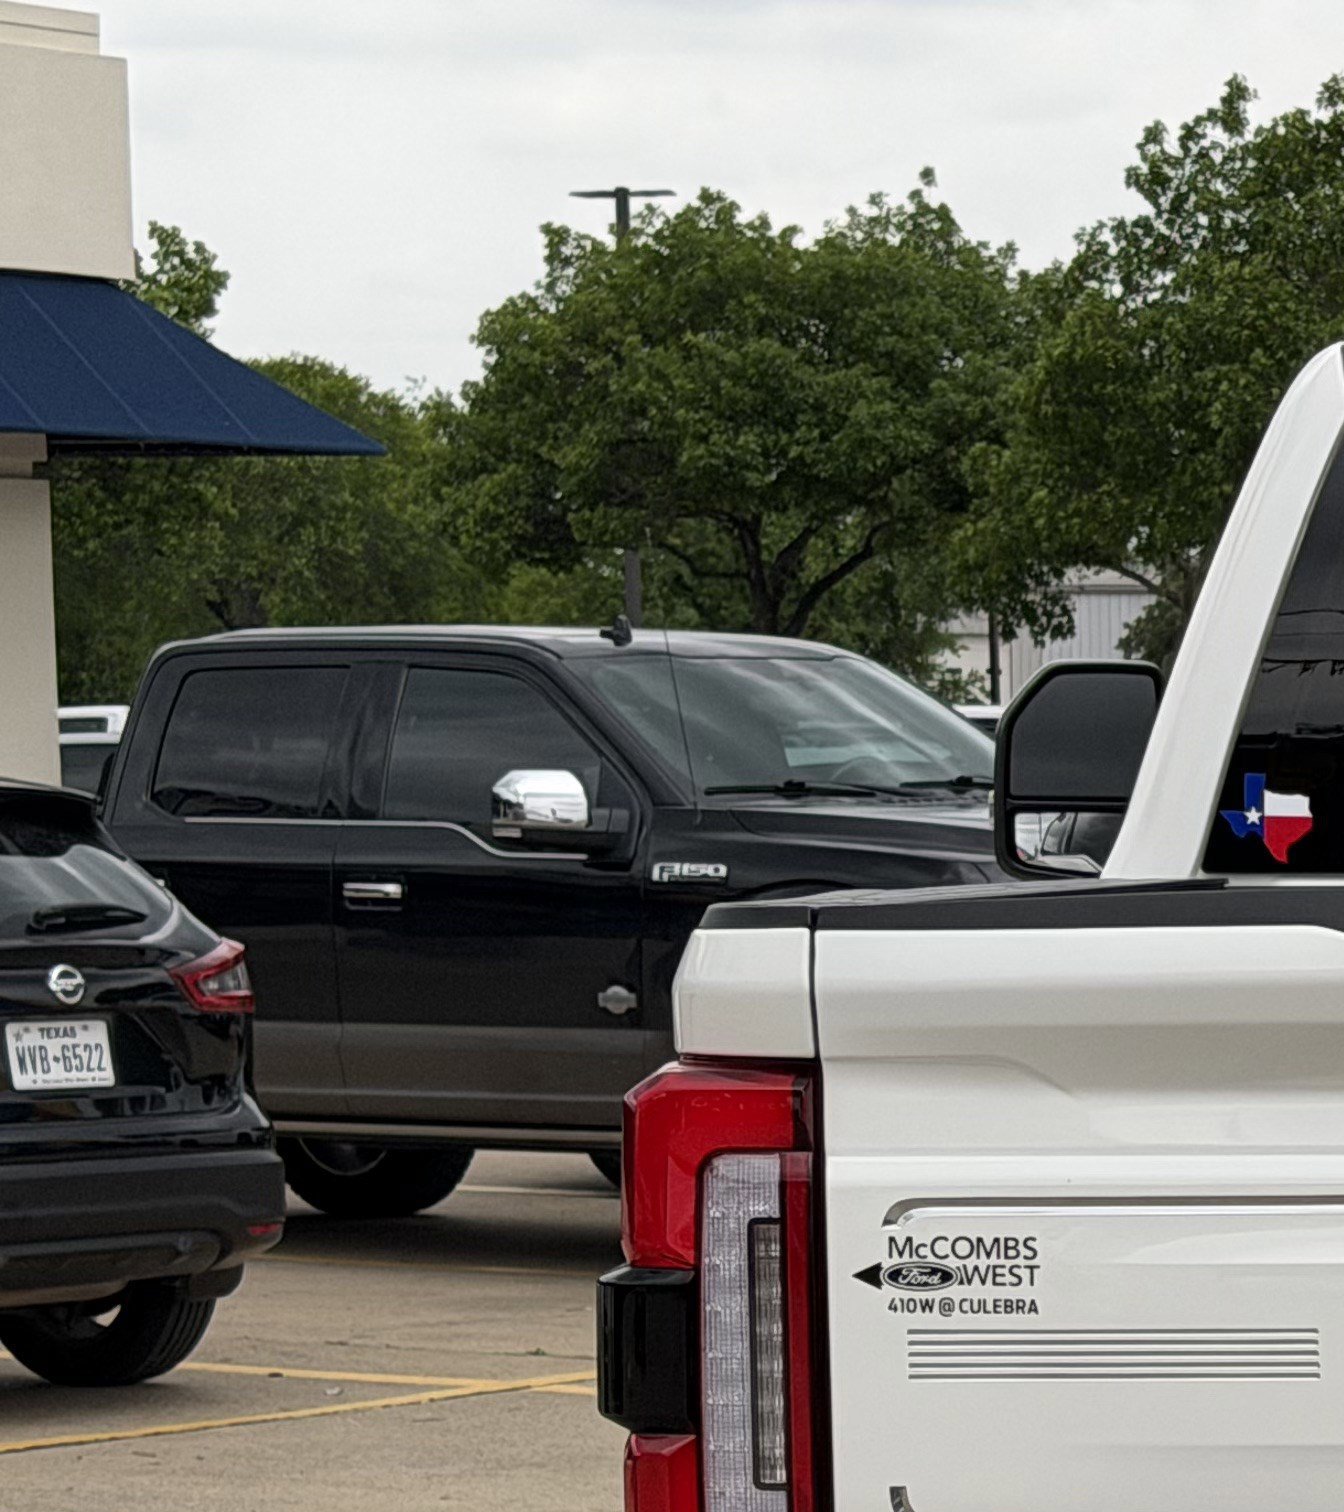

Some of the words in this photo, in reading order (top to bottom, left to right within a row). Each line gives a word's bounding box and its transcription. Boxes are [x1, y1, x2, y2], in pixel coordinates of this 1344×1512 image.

[39, 1026, 77, 1040] TEXAS
[888, 1236, 1038, 1260] McCOMBS
[962, 1265, 1041, 1286] WEST
